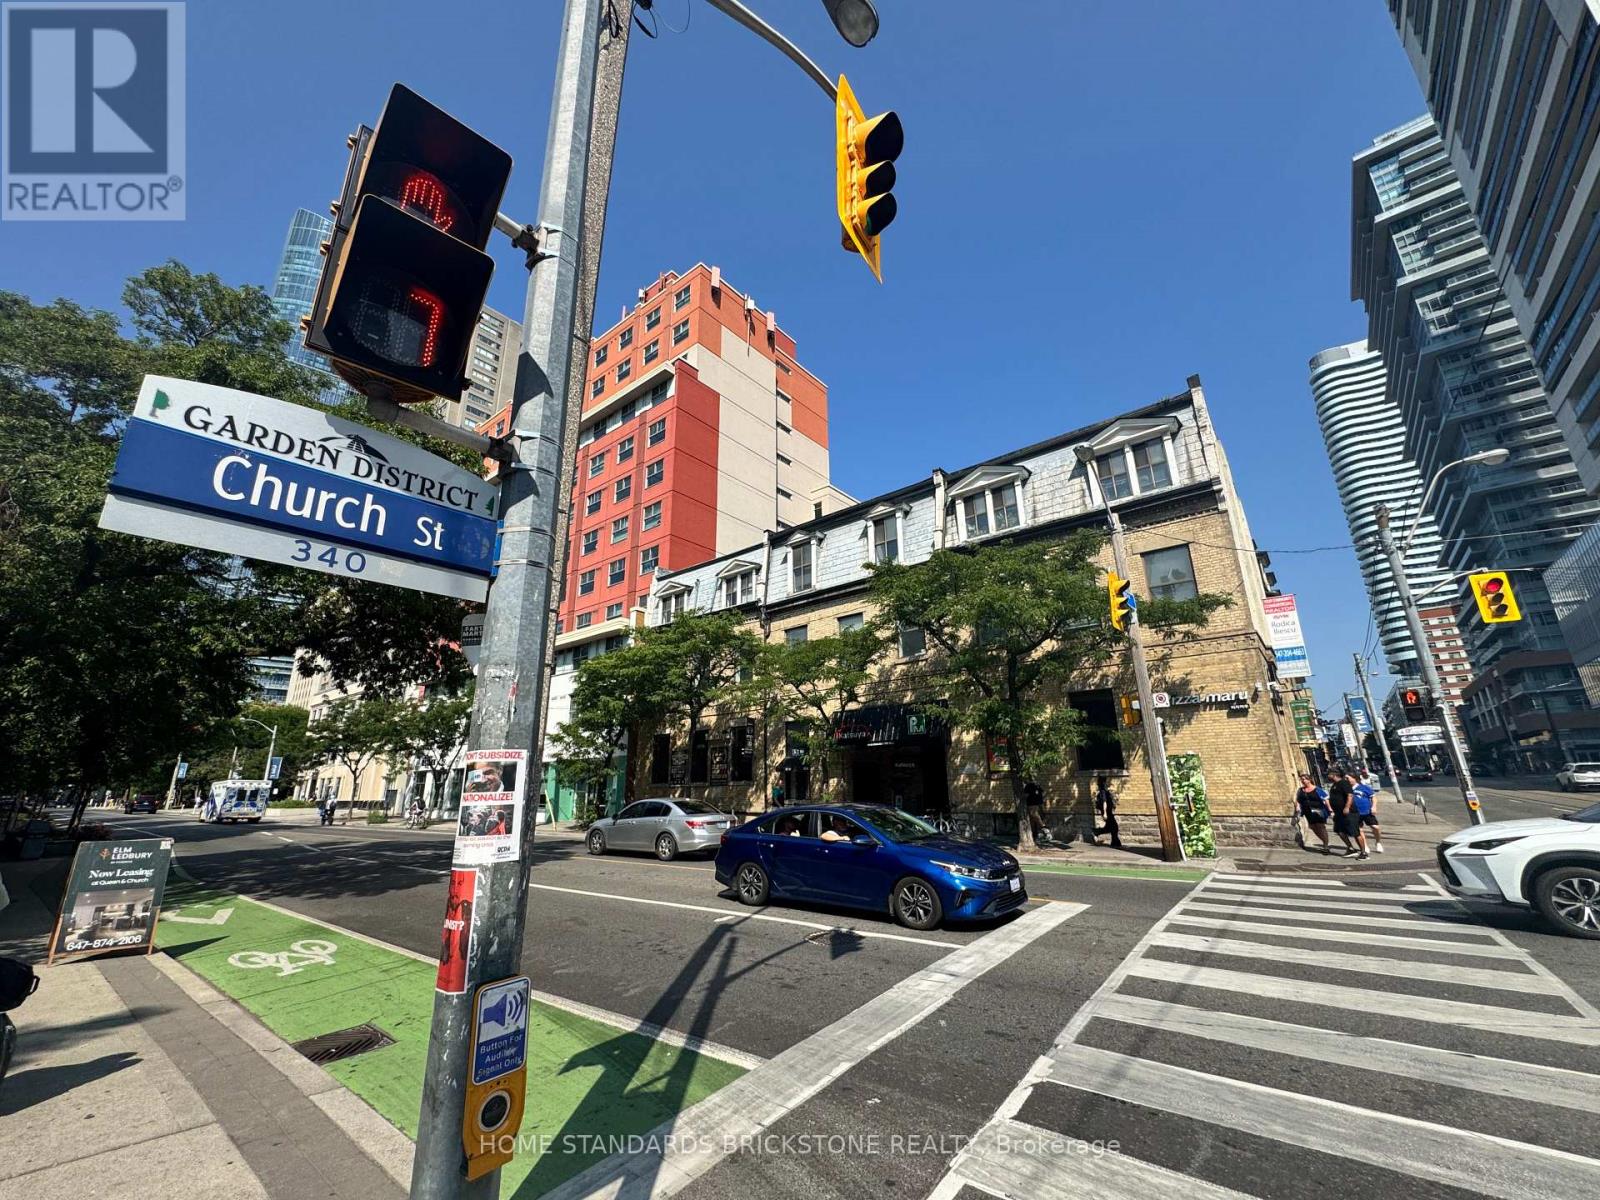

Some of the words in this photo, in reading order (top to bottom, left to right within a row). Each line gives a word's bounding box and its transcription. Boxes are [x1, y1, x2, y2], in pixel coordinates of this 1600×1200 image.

[184, 405, 342, 470] GARDEN
[351, 455, 479, 511] DISTRICT
[212, 455, 388, 537] Church
[413, 515, 445, 551] St
[290, 539, 366, 573] 340
[1206, 691, 1248, 703] maru
[111, 852, 153, 861] LEDBURY
[89, 870, 115, 879] Now
[116, 867, 155, 878] Leasing
[66, 934, 142, 951] 647-874-2106
[480, 1040, 508, 1054] Button
[509, 1034, 523, 1043] For
[504, 1056, 522, 1067] Only
